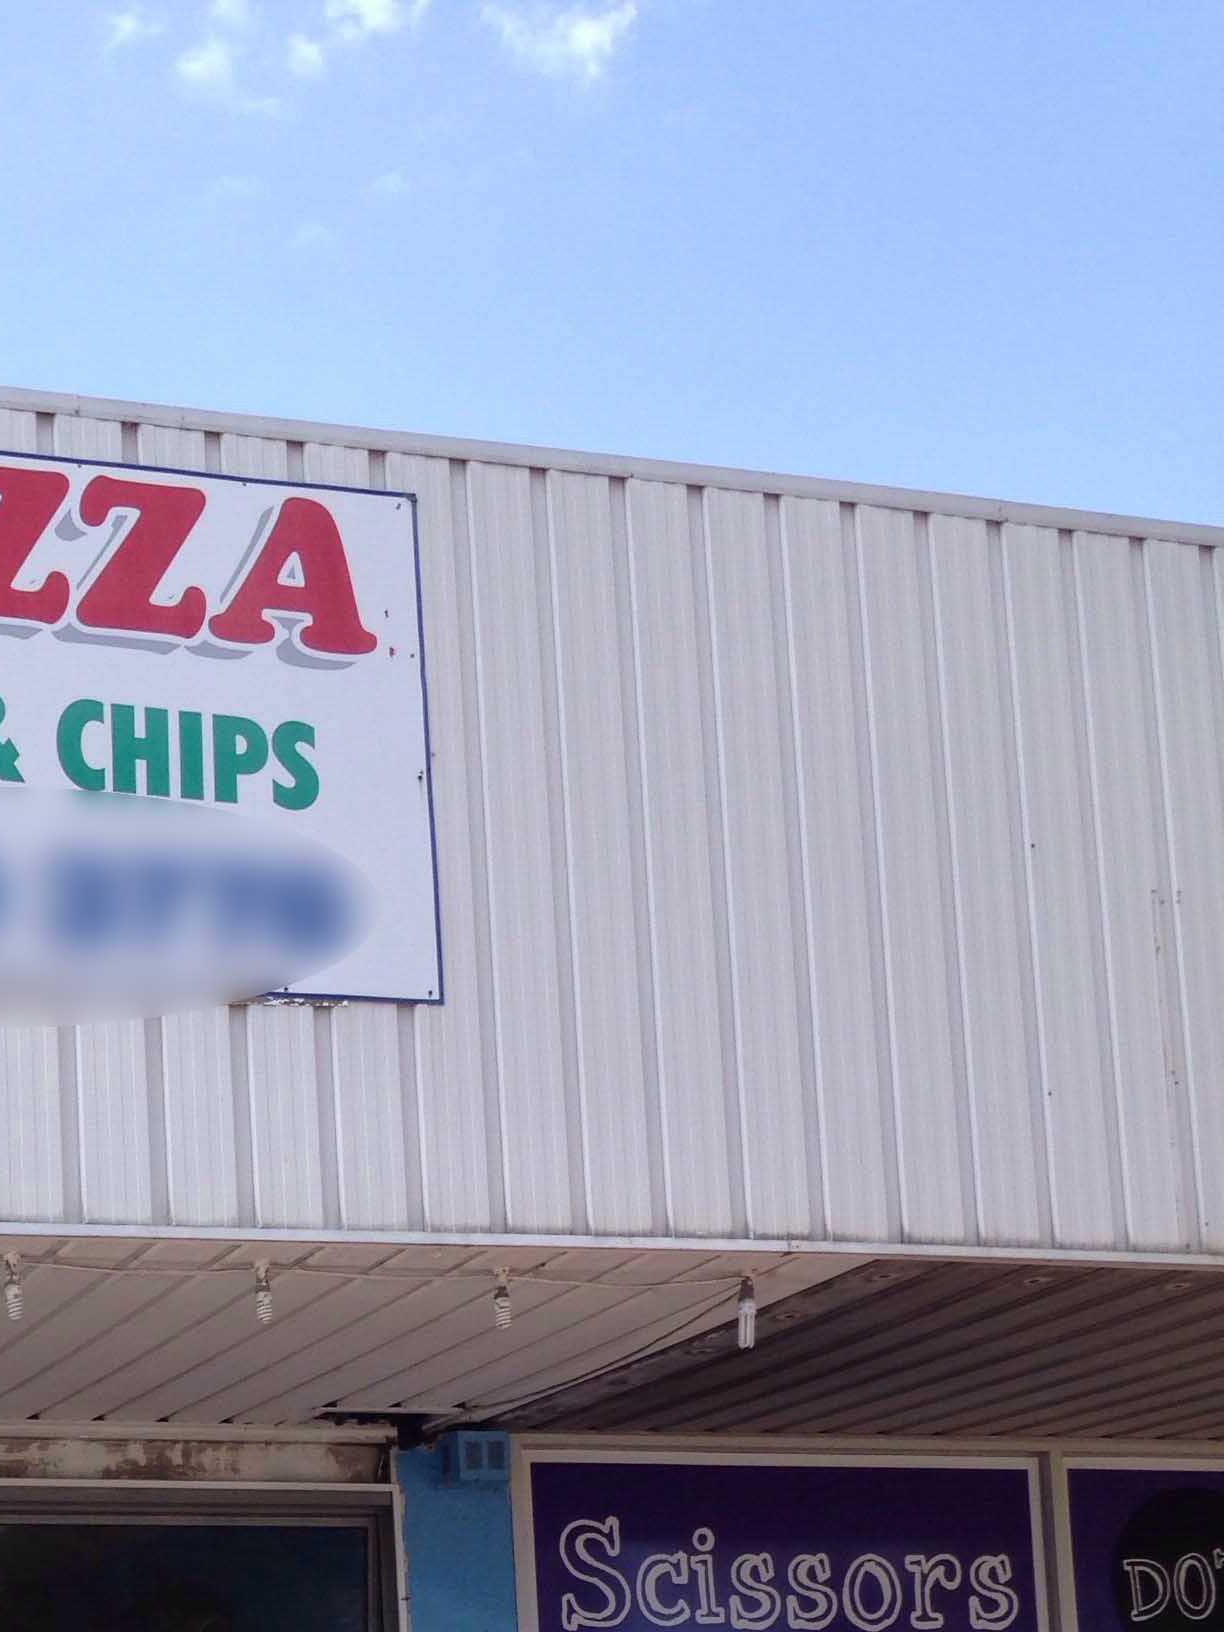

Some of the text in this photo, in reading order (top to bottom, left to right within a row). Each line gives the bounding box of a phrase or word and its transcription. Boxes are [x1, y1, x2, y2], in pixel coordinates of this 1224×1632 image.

[55, 698, 321, 812] CHIPS
[560, 1516, 1019, 1632] Scissors
[1123, 1548, 1224, 1621] DO
